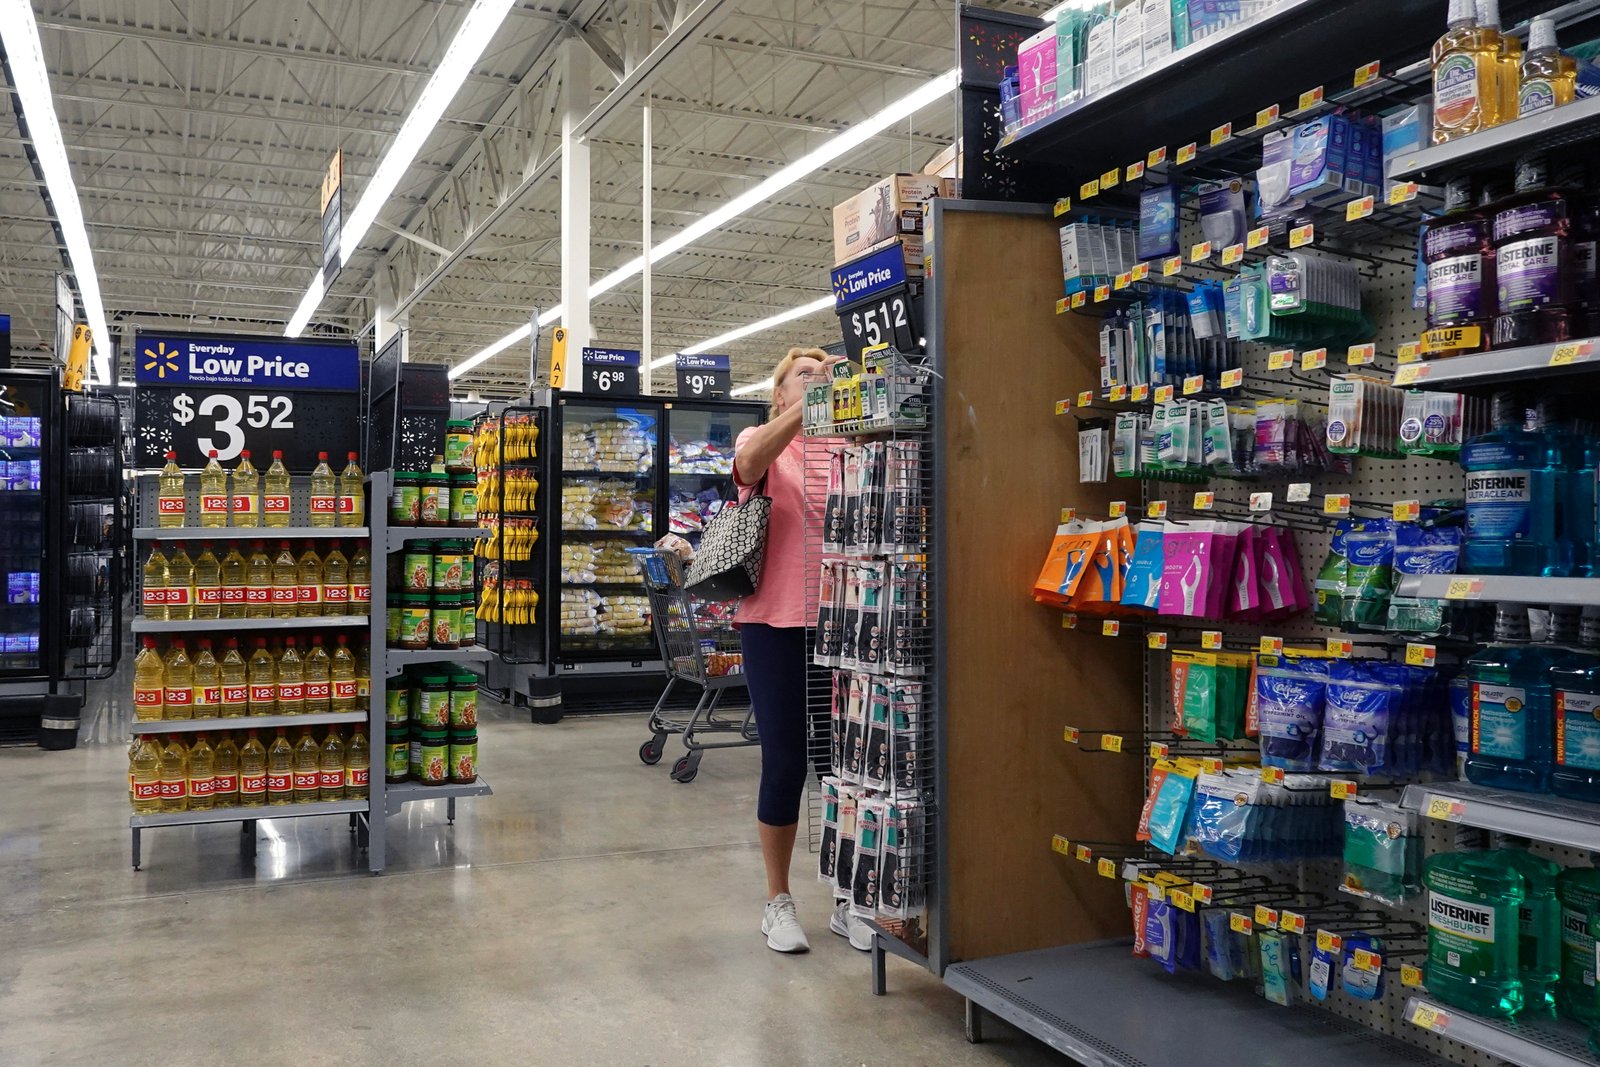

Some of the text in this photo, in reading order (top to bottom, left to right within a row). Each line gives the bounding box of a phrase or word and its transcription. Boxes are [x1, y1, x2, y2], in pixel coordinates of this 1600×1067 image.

[1499, 243, 1554, 265] LISTERINE
[1523, 256, 1549, 267] CARE
[848, 270, 864, 280] Everyday
[1428, 260, 1478, 280] LISTERINE
[849, 268, 891, 293] Low Price
[1450, 273, 1474, 282] CARE
[1426, 330, 1462, 343] VALUE
[189, 343, 235, 355] Everyday
[594, 353, 625, 362] Low Price
[1554, 347, 1576, 362] 898
[189, 353, 310, 378] Low Price
[553, 362, 561, 372] A
[687, 358, 699, 366] Low
[77, 364, 83, 374] A
[75, 378, 80, 388] 6
[553, 375, 559, 385] 7
[1333, 383, 1354, 392] GUM
[1156, 410, 1165, 419] GU
[1169, 407, 1187, 416] GUM
[1212, 407, 1224, 416] GUM
[1118, 420, 1133, 429] GUM
[1081, 434, 1098, 449] grin
[1467, 476, 1526, 491] LISTERINE
[1468, 490, 1523, 499] ULTRACLEAN
[1450, 582, 1468, 595] 898
[1473, 690, 1479, 699] 2
[1481, 690, 1504, 698] equate
[1558, 699, 1564, 708] 2
[1566, 698, 1592, 707] equate
[1249, 687, 1258, 731] Plack
[1431, 800, 1450, 813] 698
[1431, 898, 1490, 926] LISTERINE
[1431, 912, 1488, 935] FRESHBURST
[1417, 1008, 1434, 1021] 798
